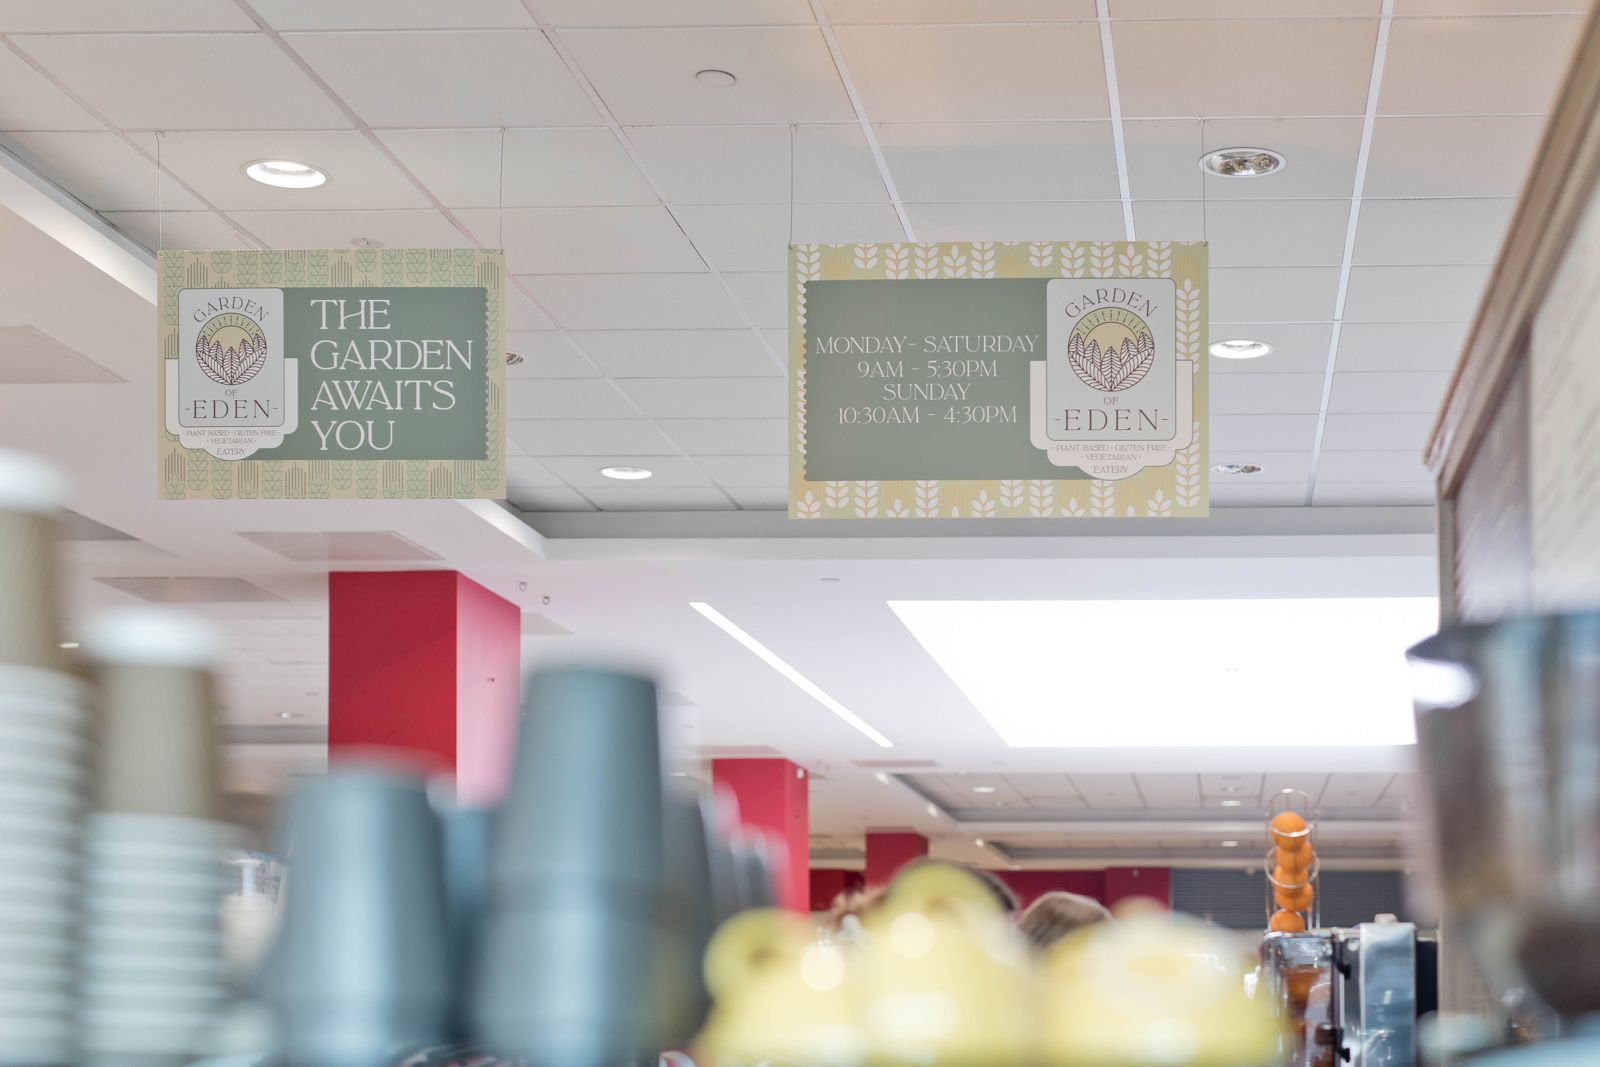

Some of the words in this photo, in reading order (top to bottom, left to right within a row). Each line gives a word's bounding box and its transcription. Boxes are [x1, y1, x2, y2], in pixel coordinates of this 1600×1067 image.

[193, 296, 269, 323] GARDEN
[1064, 287, 1158, 318] GARDEN
[310, 299, 391, 330] THE
[923, 334, 1039, 353] SATURDAY
[310, 339, 473, 370] GARDEN
[857, 361, 904, 379] 9AM
[224, 388, 238, 397] OF
[310, 380, 456, 411] AWAITS
[883, 383, 972, 401] SUNDAY
[1103, 396, 1119, 406] OF
[838, 406, 920, 424] 10:30AM
[943, 405, 1017, 424] 4:30PM
[310, 420, 395, 451] YOU
[1083, 444, 1109, 452] BASED
[1085, 453, 1137, 461] VEGETARIAN
[1093, 465, 1129, 474] EATERY
